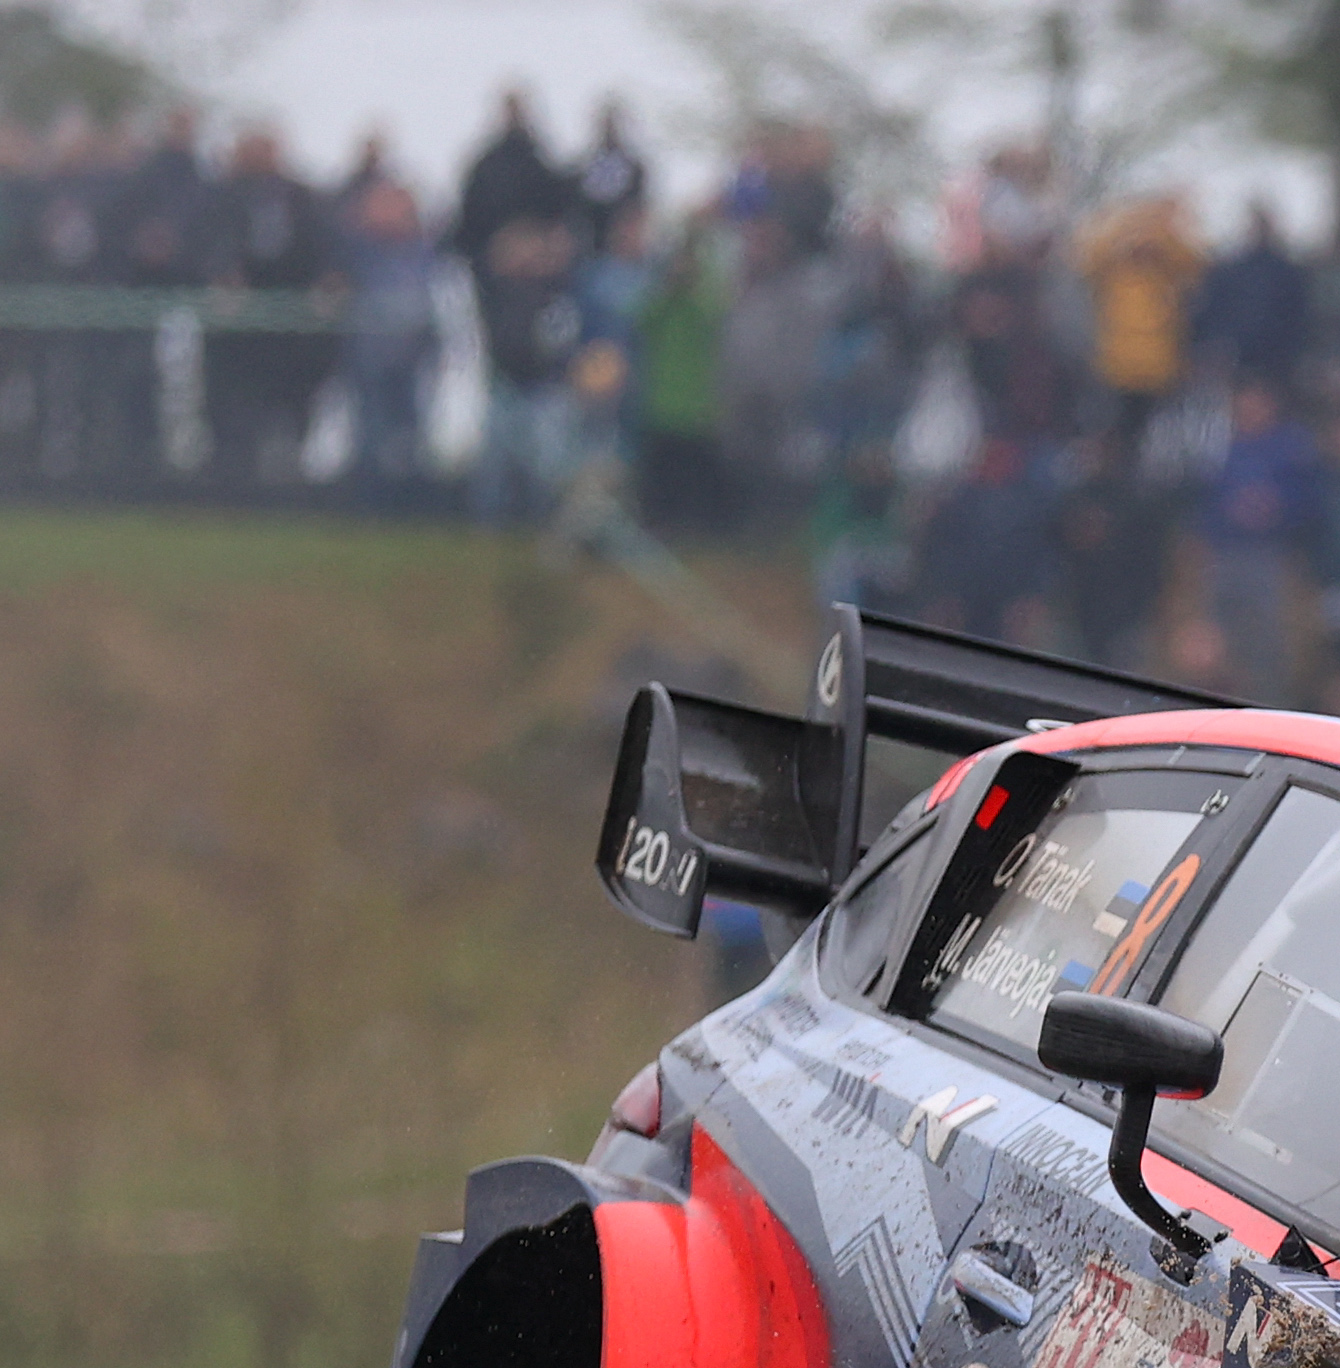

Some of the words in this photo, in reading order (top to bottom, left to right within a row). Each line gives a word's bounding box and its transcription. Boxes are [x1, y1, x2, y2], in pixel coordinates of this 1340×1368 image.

[993, 833, 1037, 890] O.
[1017, 841, 1095, 914] Tänak
[931, 912, 982, 975] M.
[961, 924, 1058, 1020] Järveoja
[899, 1084, 999, 1168] N
